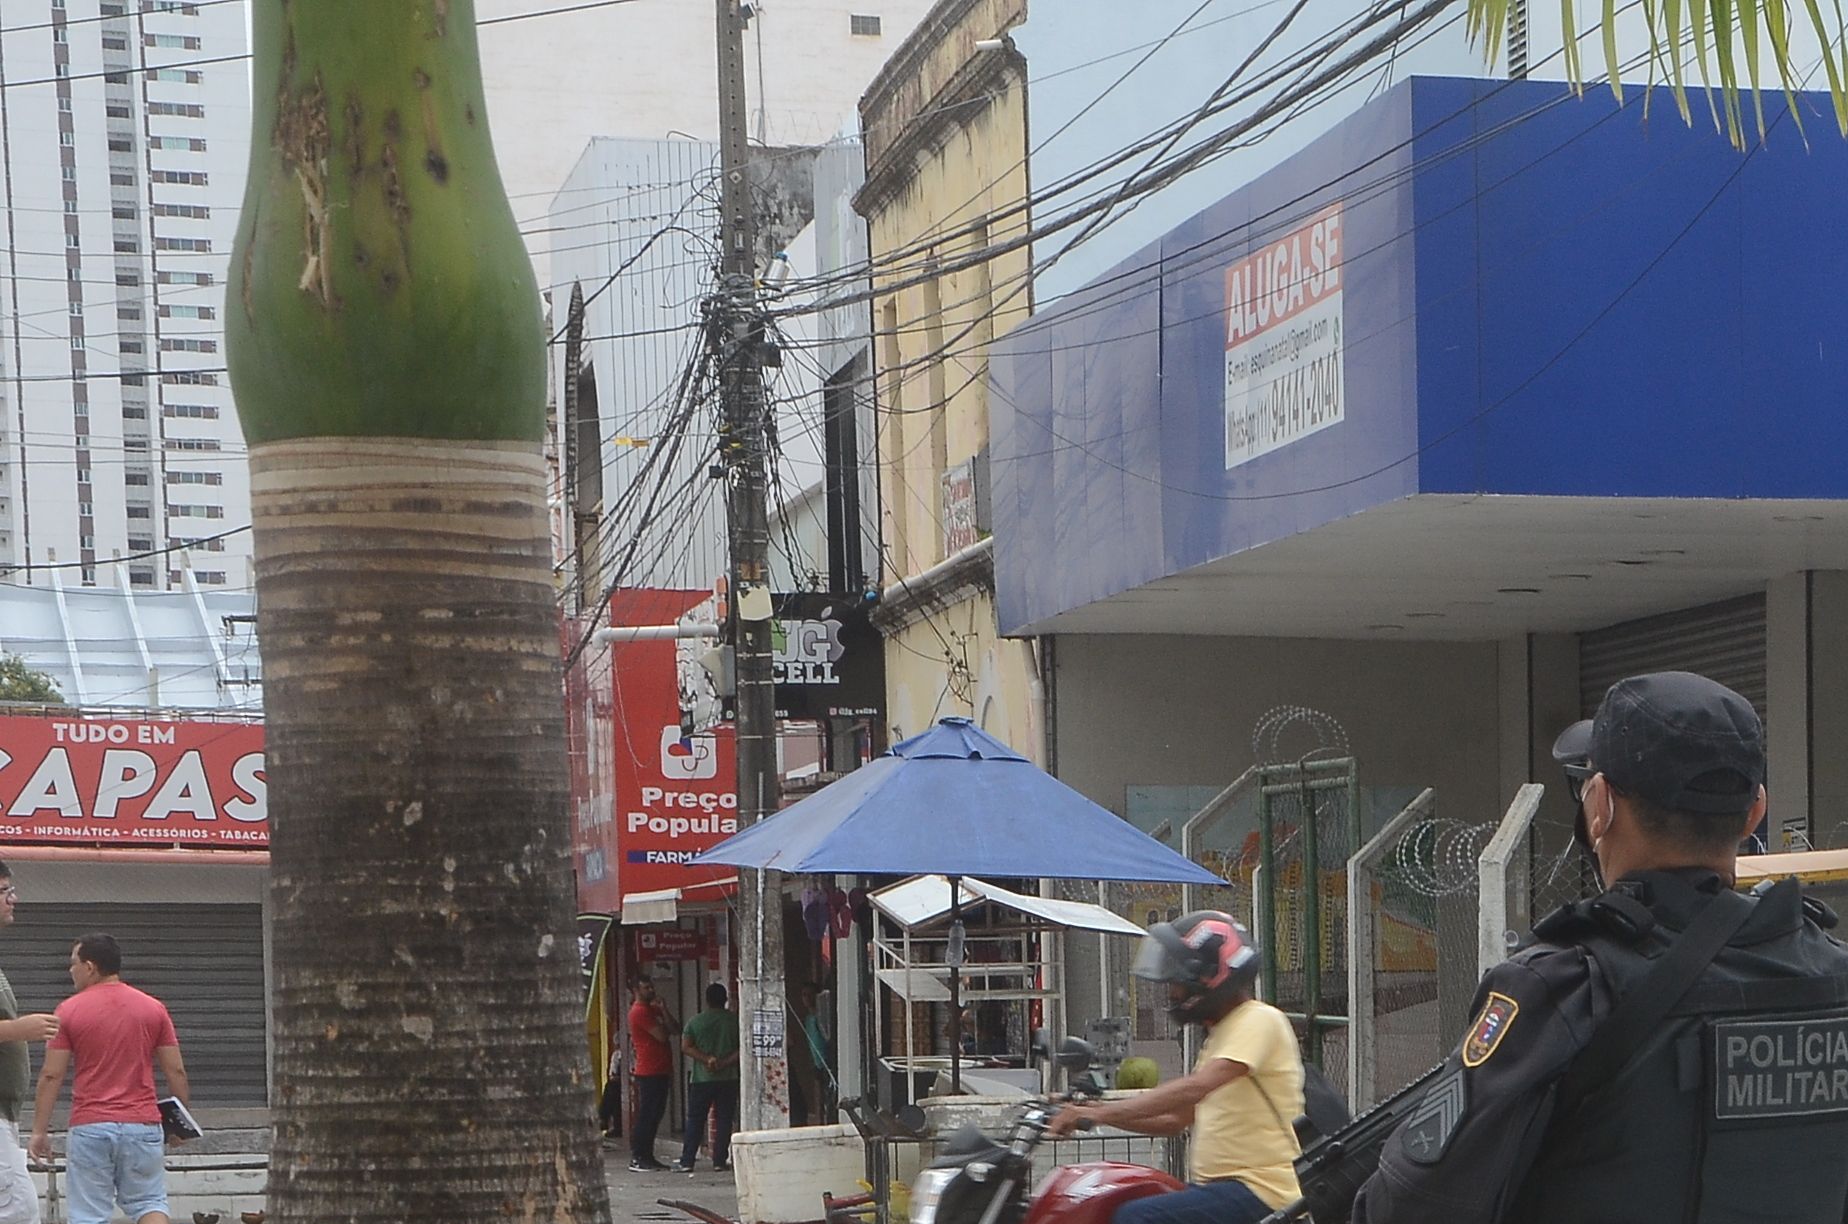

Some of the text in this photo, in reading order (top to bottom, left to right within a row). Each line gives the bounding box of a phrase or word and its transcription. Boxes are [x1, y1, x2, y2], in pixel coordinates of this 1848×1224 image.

[1227, 212, 1339, 343] ALUGA-SE
[1272, 350, 1339, 443] 94141-2040
[772, 662, 840, 684] CELL
[53, 723, 175, 744] TUDO EM
[0, 747, 269, 822] APAS
[642, 787, 737, 812] Preço
[34, 824, 120, 838] INFORMÁTICA
[132, 827, 208, 839] ACESSÓRIOS
[219, 829, 270, 841] TABACA
[627, 812, 738, 837] Popula
